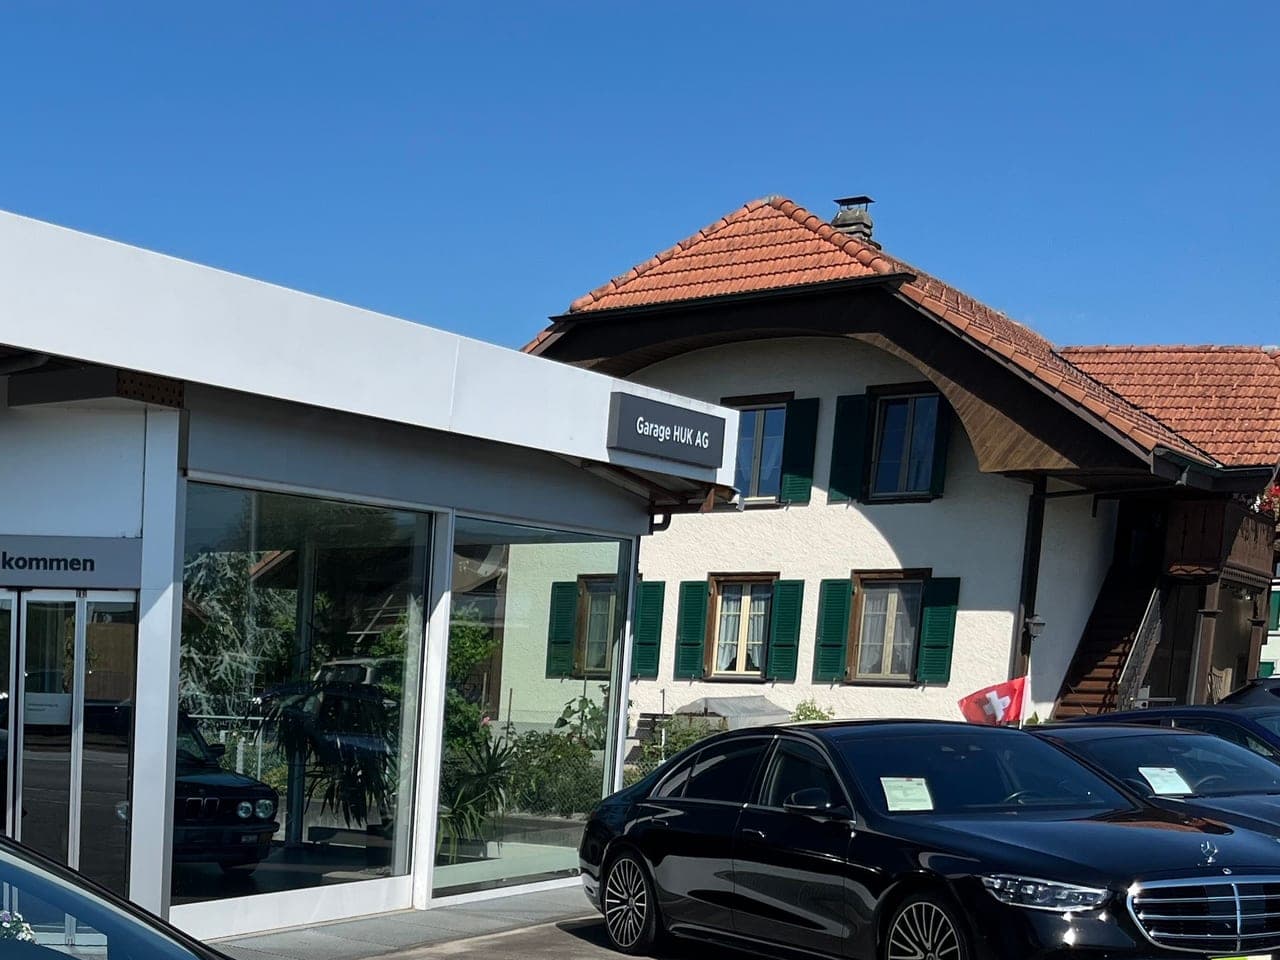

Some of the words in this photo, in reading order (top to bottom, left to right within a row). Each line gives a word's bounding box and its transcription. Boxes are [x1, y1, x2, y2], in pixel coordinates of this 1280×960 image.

[636, 416, 671, 442] Garage
[673, 425, 694, 445] HUK
[695, 430, 709, 449] AG
